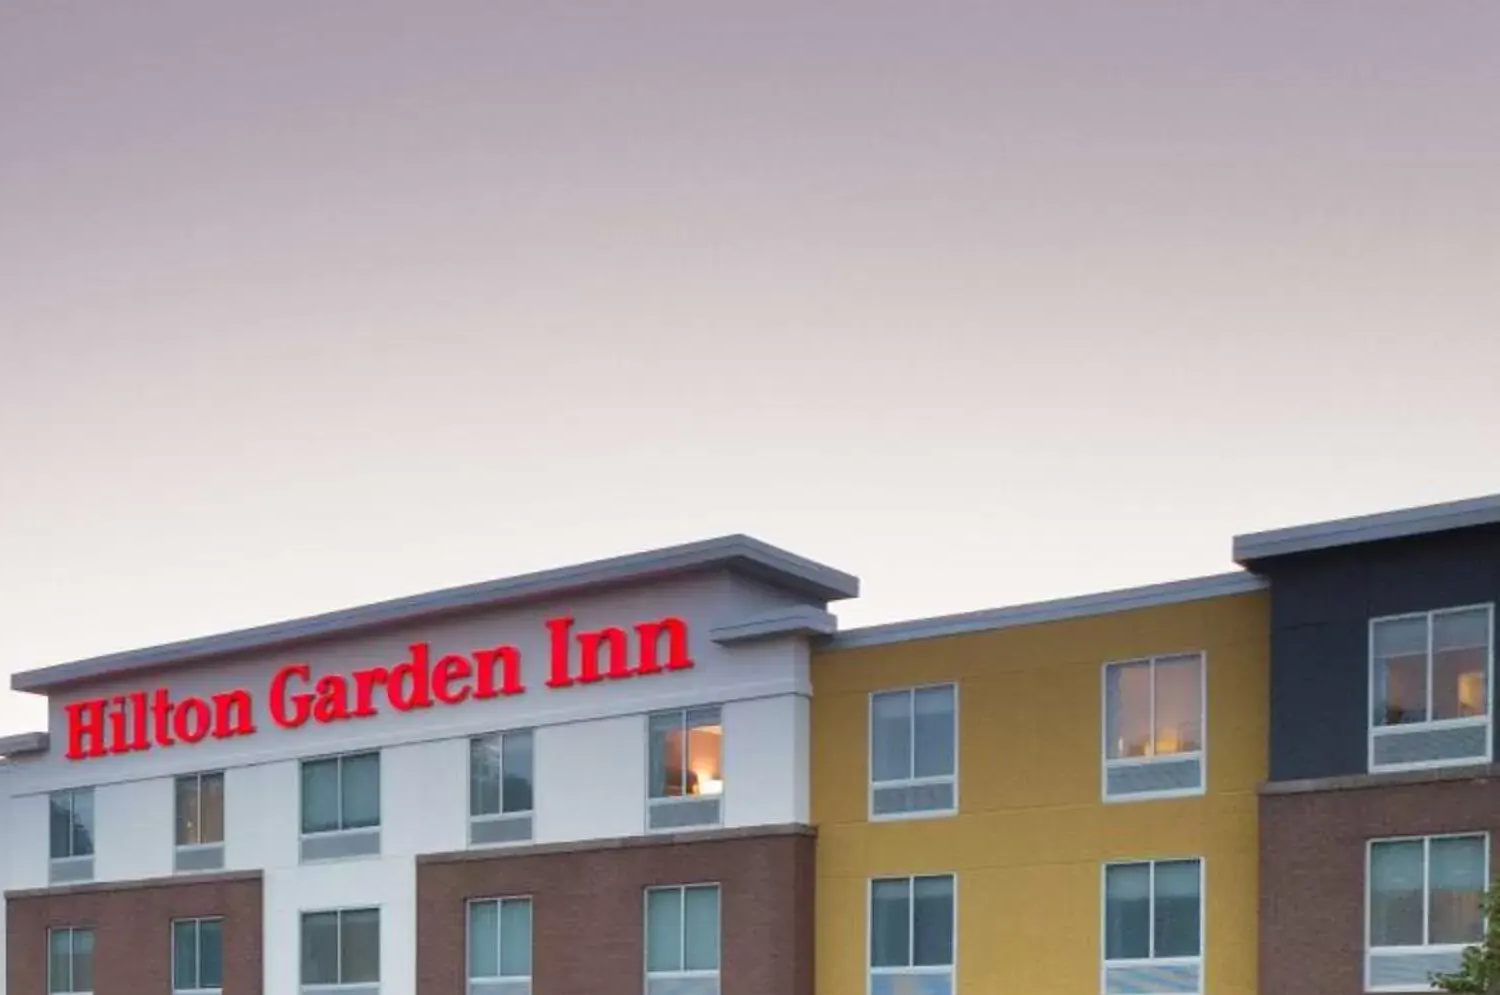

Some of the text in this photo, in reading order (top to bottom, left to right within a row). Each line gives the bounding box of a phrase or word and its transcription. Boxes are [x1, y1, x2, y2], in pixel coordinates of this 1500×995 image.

[64, 614, 693, 760] Hilton Garden Inn
